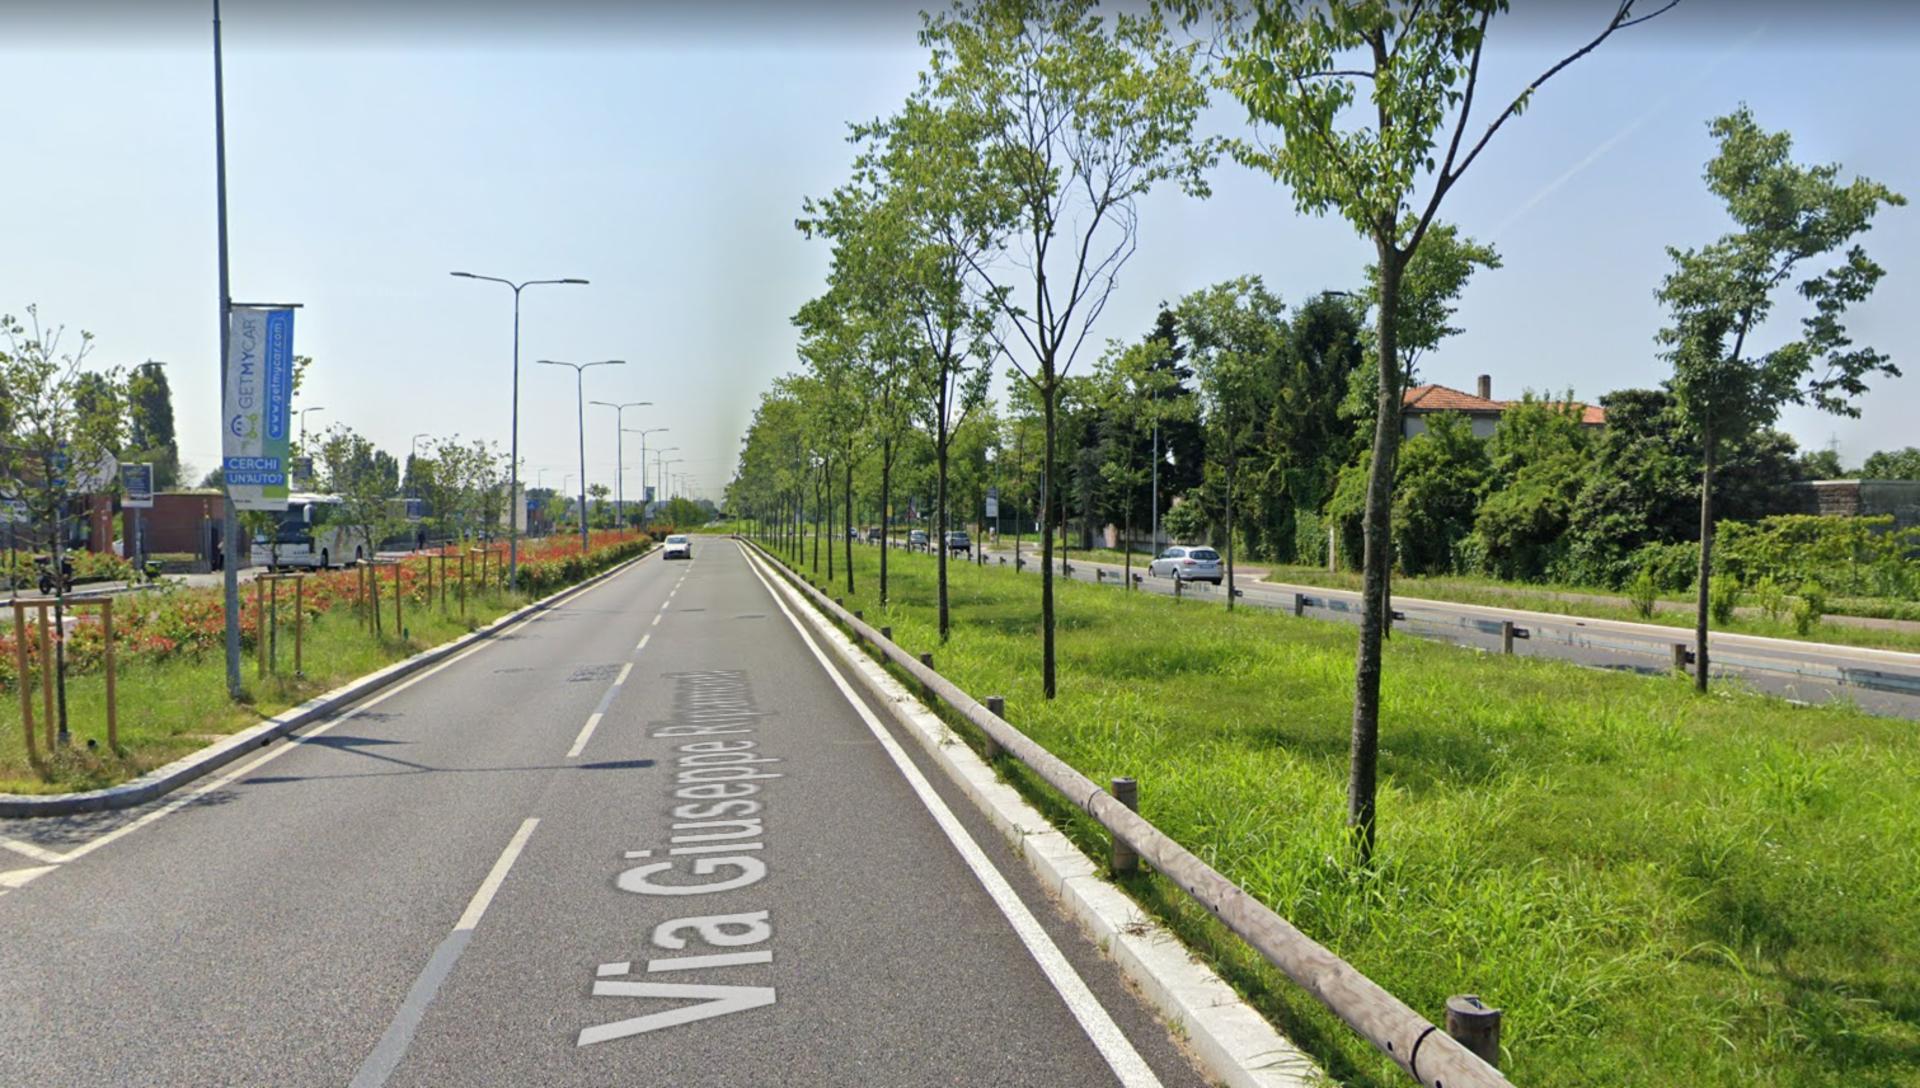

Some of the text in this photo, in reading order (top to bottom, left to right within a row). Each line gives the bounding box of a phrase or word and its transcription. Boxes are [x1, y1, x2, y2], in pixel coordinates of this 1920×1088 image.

[239, 319, 257, 410] GETMYCAR
[271, 322, 284, 434] www.getmycar.com
[228, 458, 277, 470] CERCHI
[229, 473, 283, 484] UN'AUTO?
